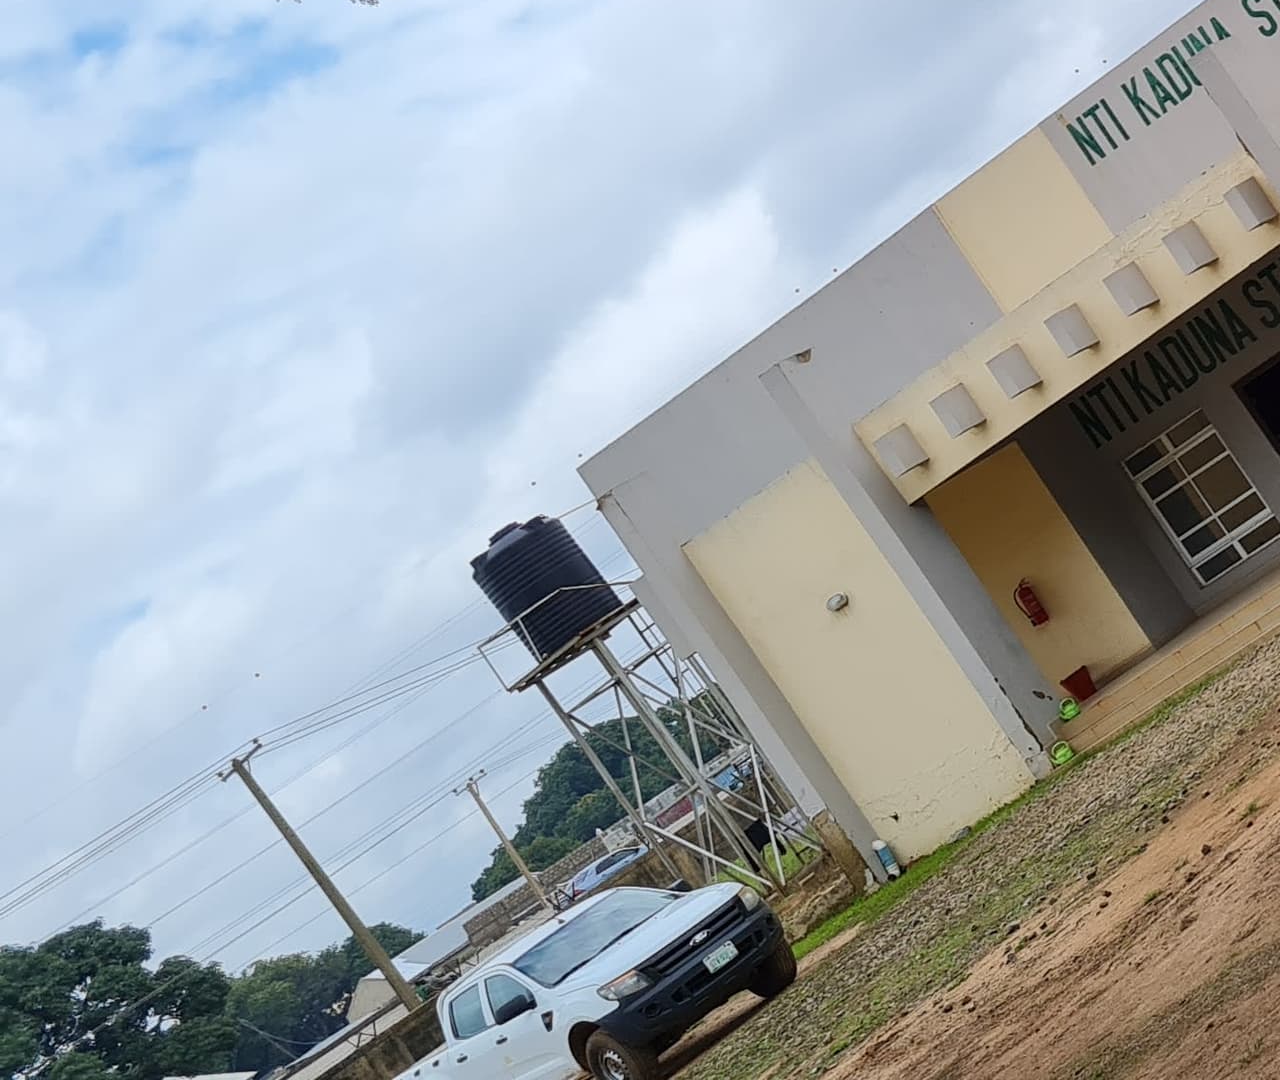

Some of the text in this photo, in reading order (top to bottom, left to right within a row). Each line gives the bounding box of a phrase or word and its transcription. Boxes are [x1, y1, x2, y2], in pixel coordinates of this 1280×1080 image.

[1066, 99, 1131, 166] NTI
[1068, 376, 1140, 449] NTI
[1120, 298, 1257, 415] KADUNA
